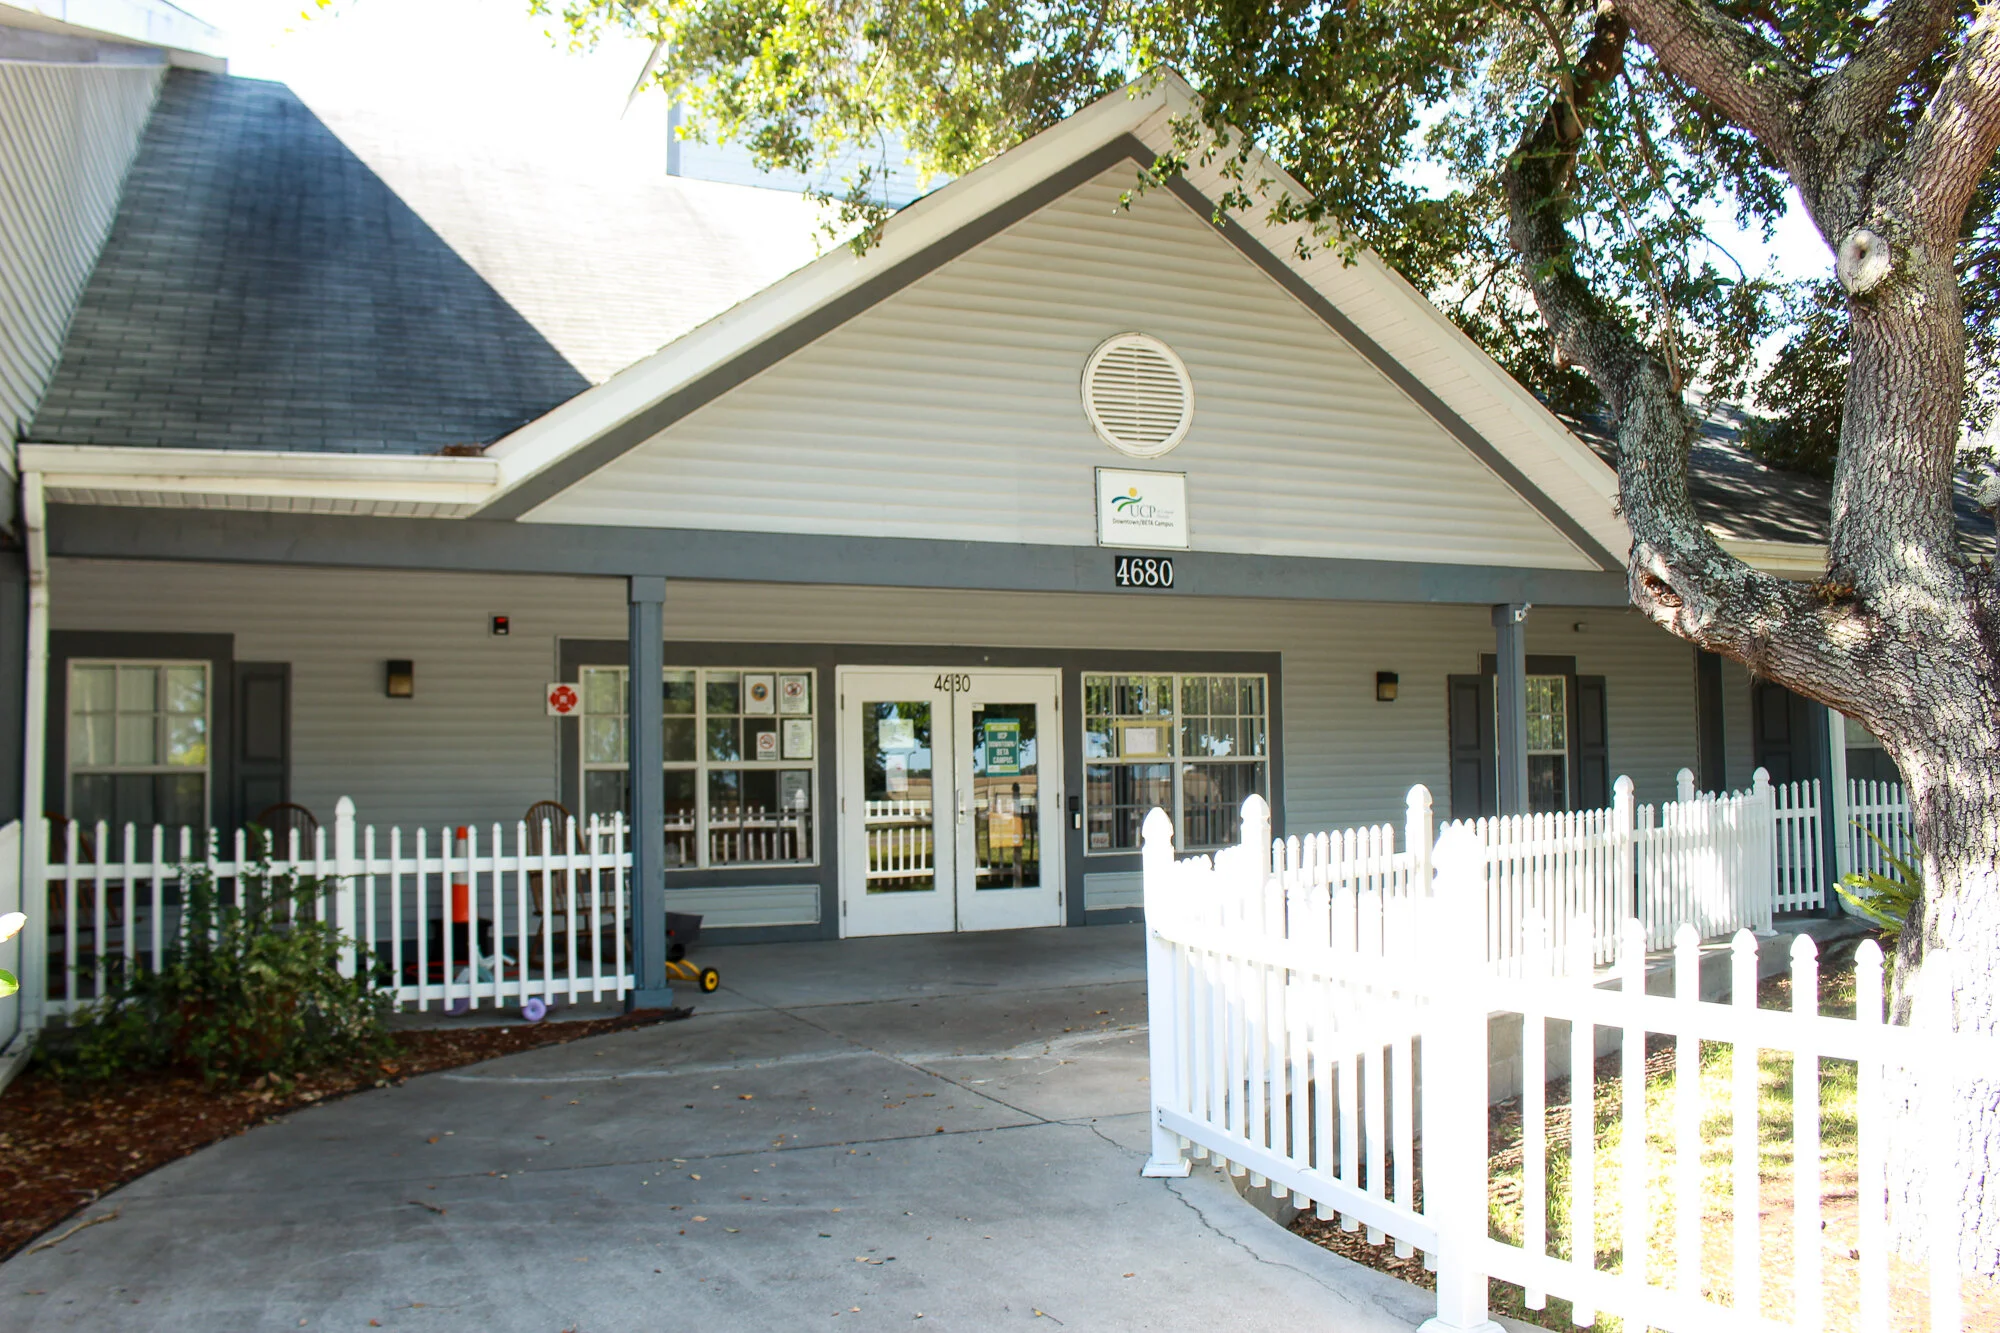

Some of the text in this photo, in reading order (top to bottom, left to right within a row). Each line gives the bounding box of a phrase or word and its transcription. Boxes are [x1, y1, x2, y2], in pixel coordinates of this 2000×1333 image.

[1130, 504, 1156, 518] UCP
[1116, 558, 1174, 587] 4680
[997, 732, 1008, 740] UCP
[996, 748, 1009, 756] BETA
[993, 756, 1014, 764] CAMPUS
